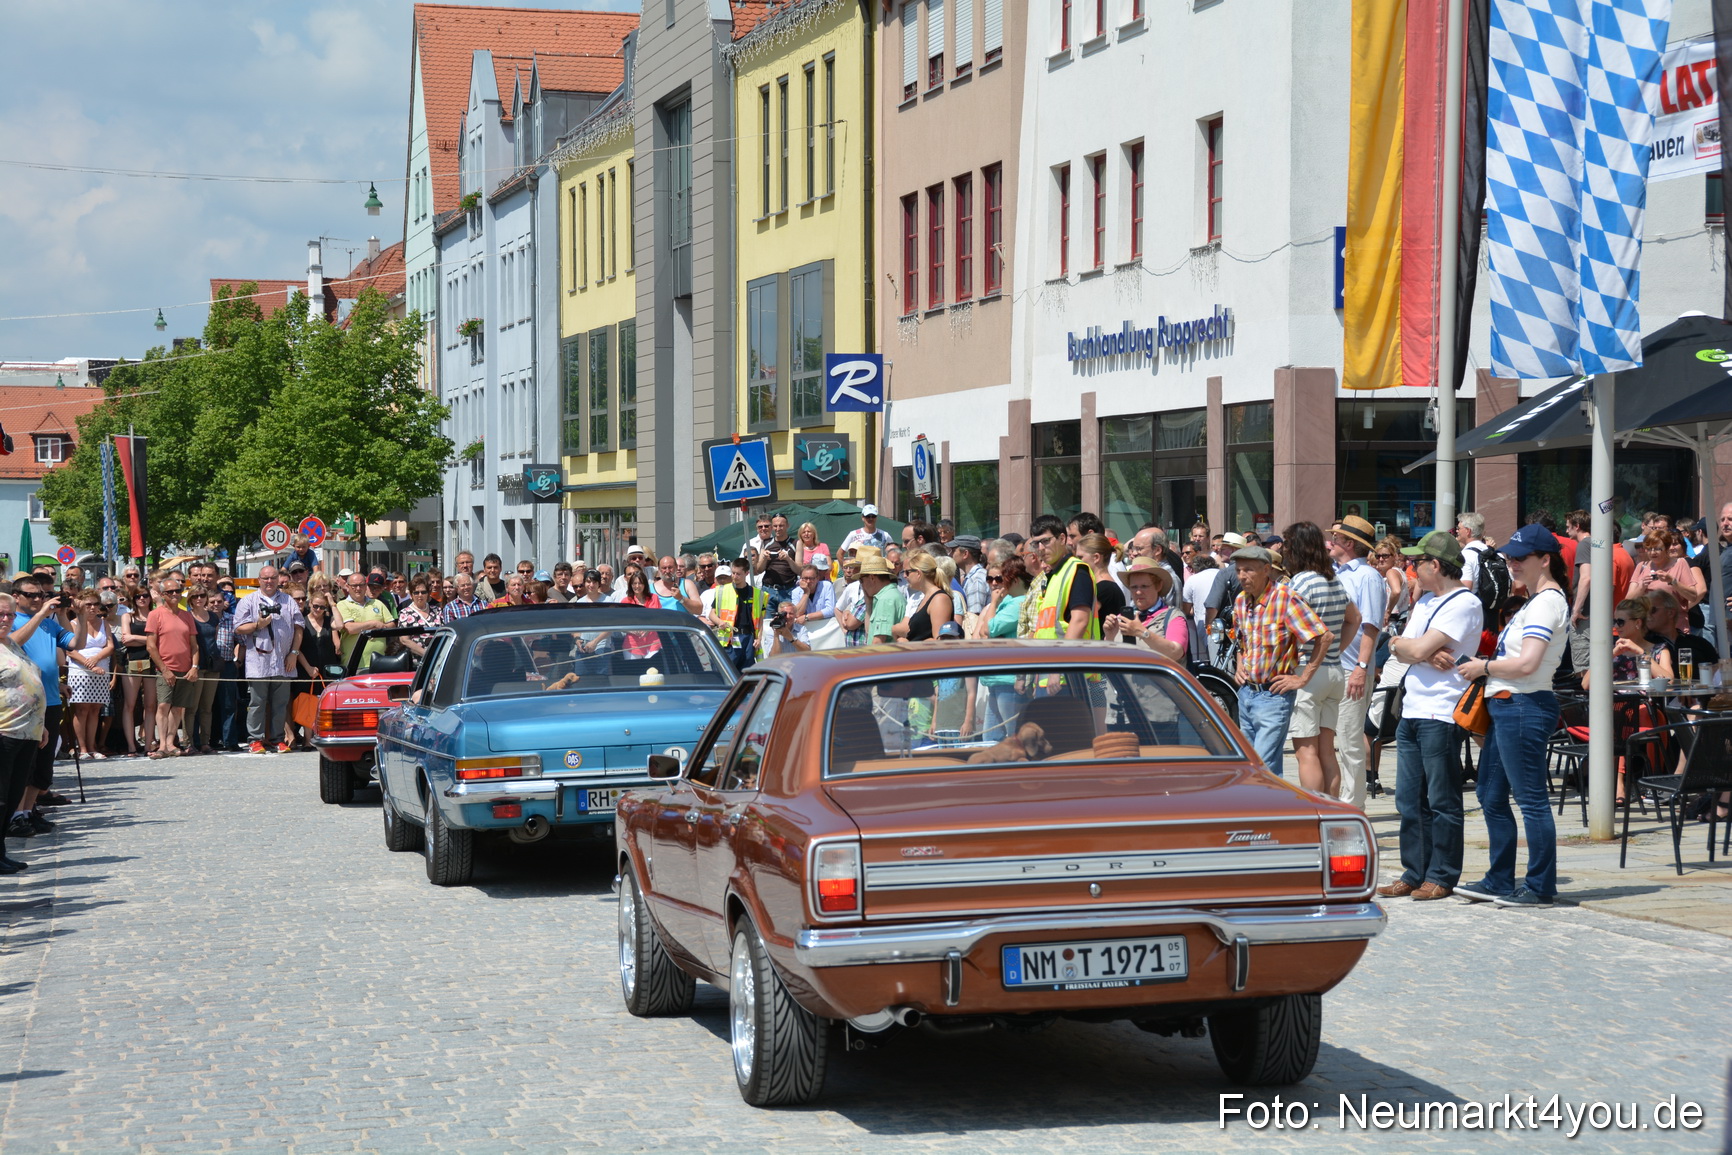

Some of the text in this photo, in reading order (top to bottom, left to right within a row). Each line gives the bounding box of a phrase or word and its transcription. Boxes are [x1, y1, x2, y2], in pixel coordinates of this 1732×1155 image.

[1660, 58, 1717, 114] LAT
[1068, 304, 1230, 361] Buchhandlung Rupprecht
[814, 448, 834, 472] G2
[537, 474, 551, 491] G2
[917, 481, 927, 491] ZONE
[267, 529, 285, 543] 30
[567, 754, 579, 765] DAS
[588, 789, 610, 807] RH
[1226, 830, 1271, 844] Taunus
[1021, 860, 1167, 873] FORD
[1168, 942, 1180, 951] 05
[1022, 943, 1165, 981] NM T 1971
[1169, 962, 1181, 971] 07
[1009, 970, 1017, 980] D
[1065, 980, 1129, 990] FREISTAAT BAYERN
